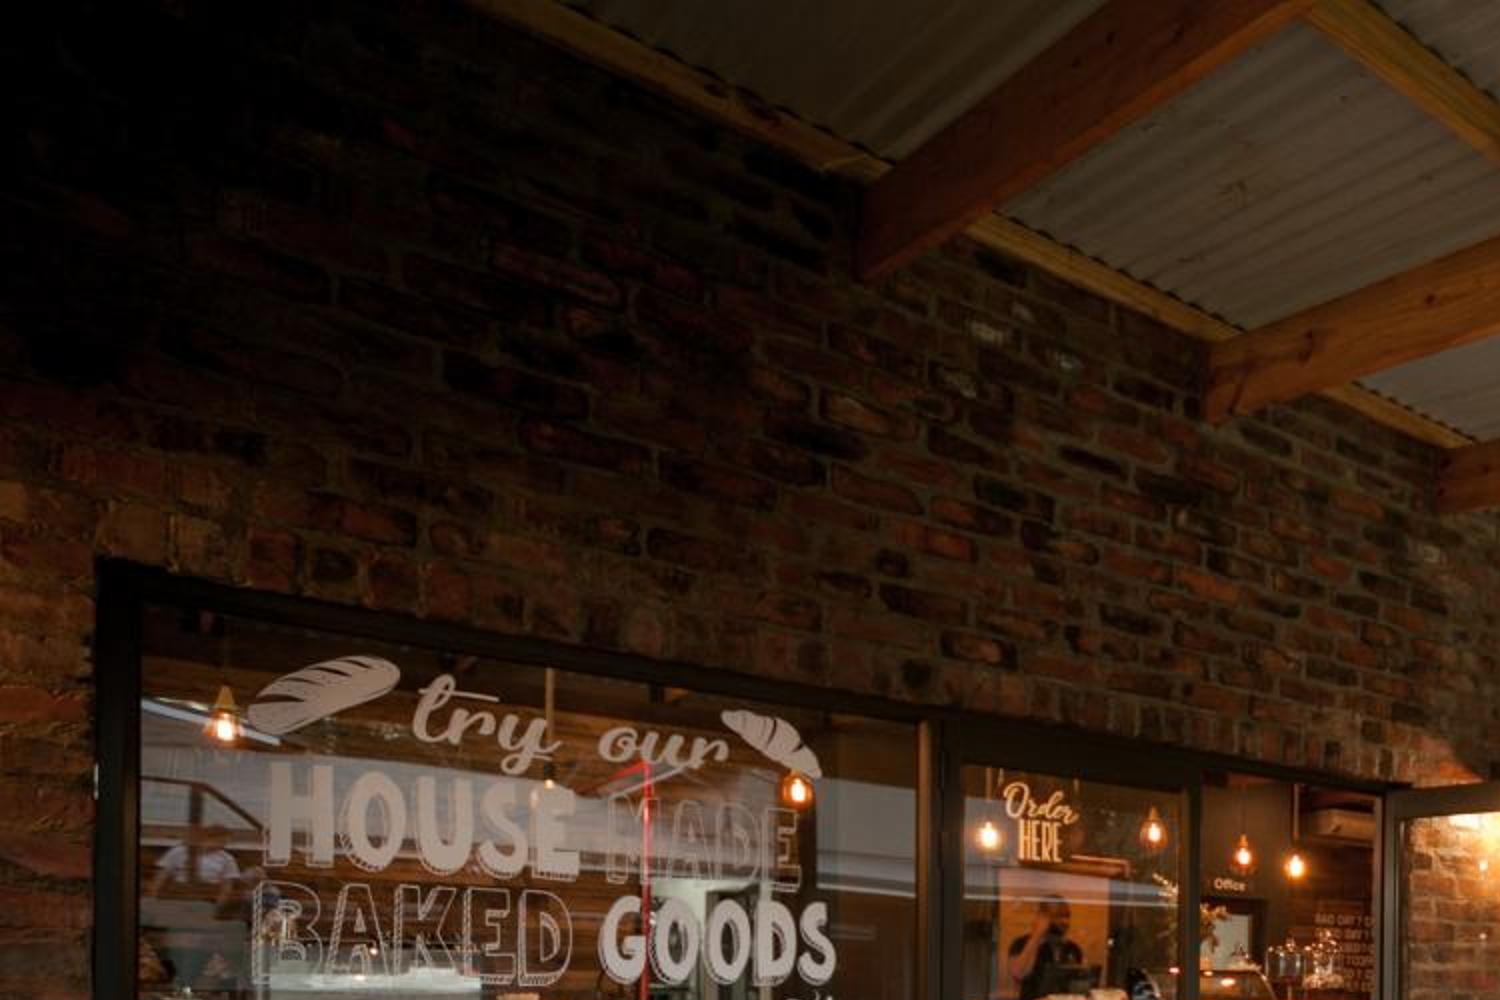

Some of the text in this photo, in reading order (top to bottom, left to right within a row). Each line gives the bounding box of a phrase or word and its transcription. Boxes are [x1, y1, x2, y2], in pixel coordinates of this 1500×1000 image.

[412, 674, 728, 774] try our
[263, 763, 801, 892] HOUSE MADE
[1003, 782, 1079, 825] Order
[1018, 819, 1063, 863] HERE
[1214, 877, 1247, 892] Office
[253, 882, 837, 987] BAKED GOODS
